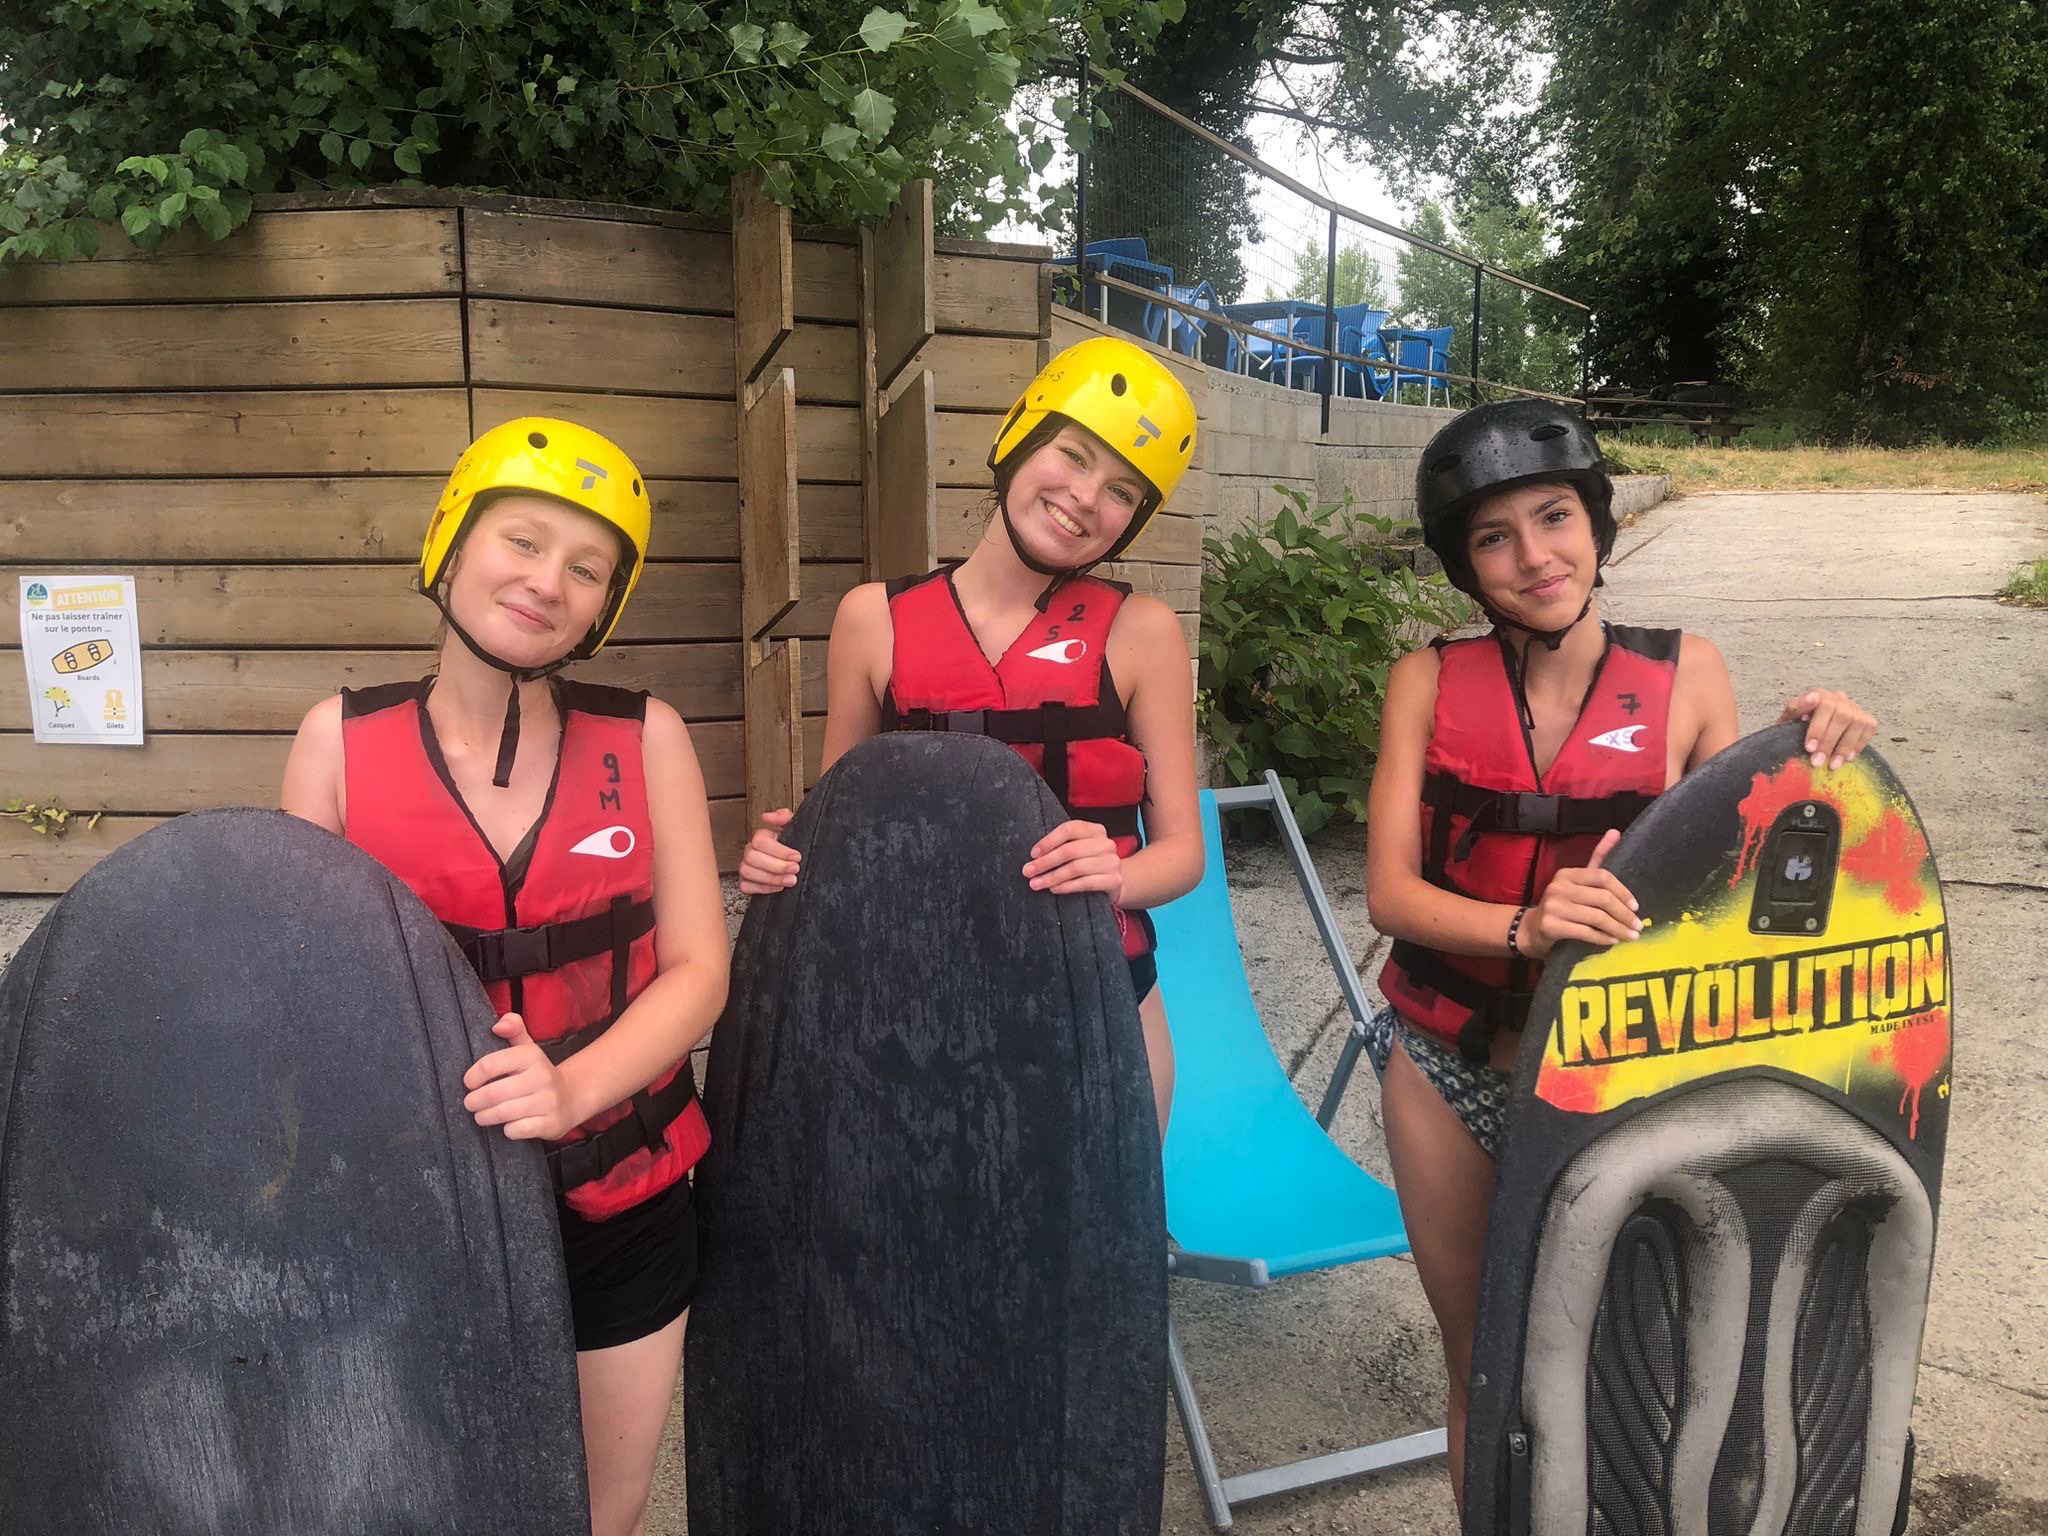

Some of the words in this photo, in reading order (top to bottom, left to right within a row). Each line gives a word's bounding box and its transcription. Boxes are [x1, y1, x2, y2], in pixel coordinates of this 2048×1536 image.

[56, 589, 118, 606] ATTENTION
[45, 614, 61, 622] pas
[62, 612, 90, 620] laisser
[92, 612, 123, 620] traîner
[1066, 603, 1087, 622] 2
[61, 625, 70, 633] le
[71, 625, 103, 635] ponton
[1616, 692, 1642, 716] 7
[48, 722, 75, 730] Casques
[602, 752, 621, 783] 9
[599, 787, 622, 811] M
[1870, 1021, 1900, 1035] MADE
[1902, 1018, 1913, 1029] IN
[1916, 1014, 1935, 1026] USA
